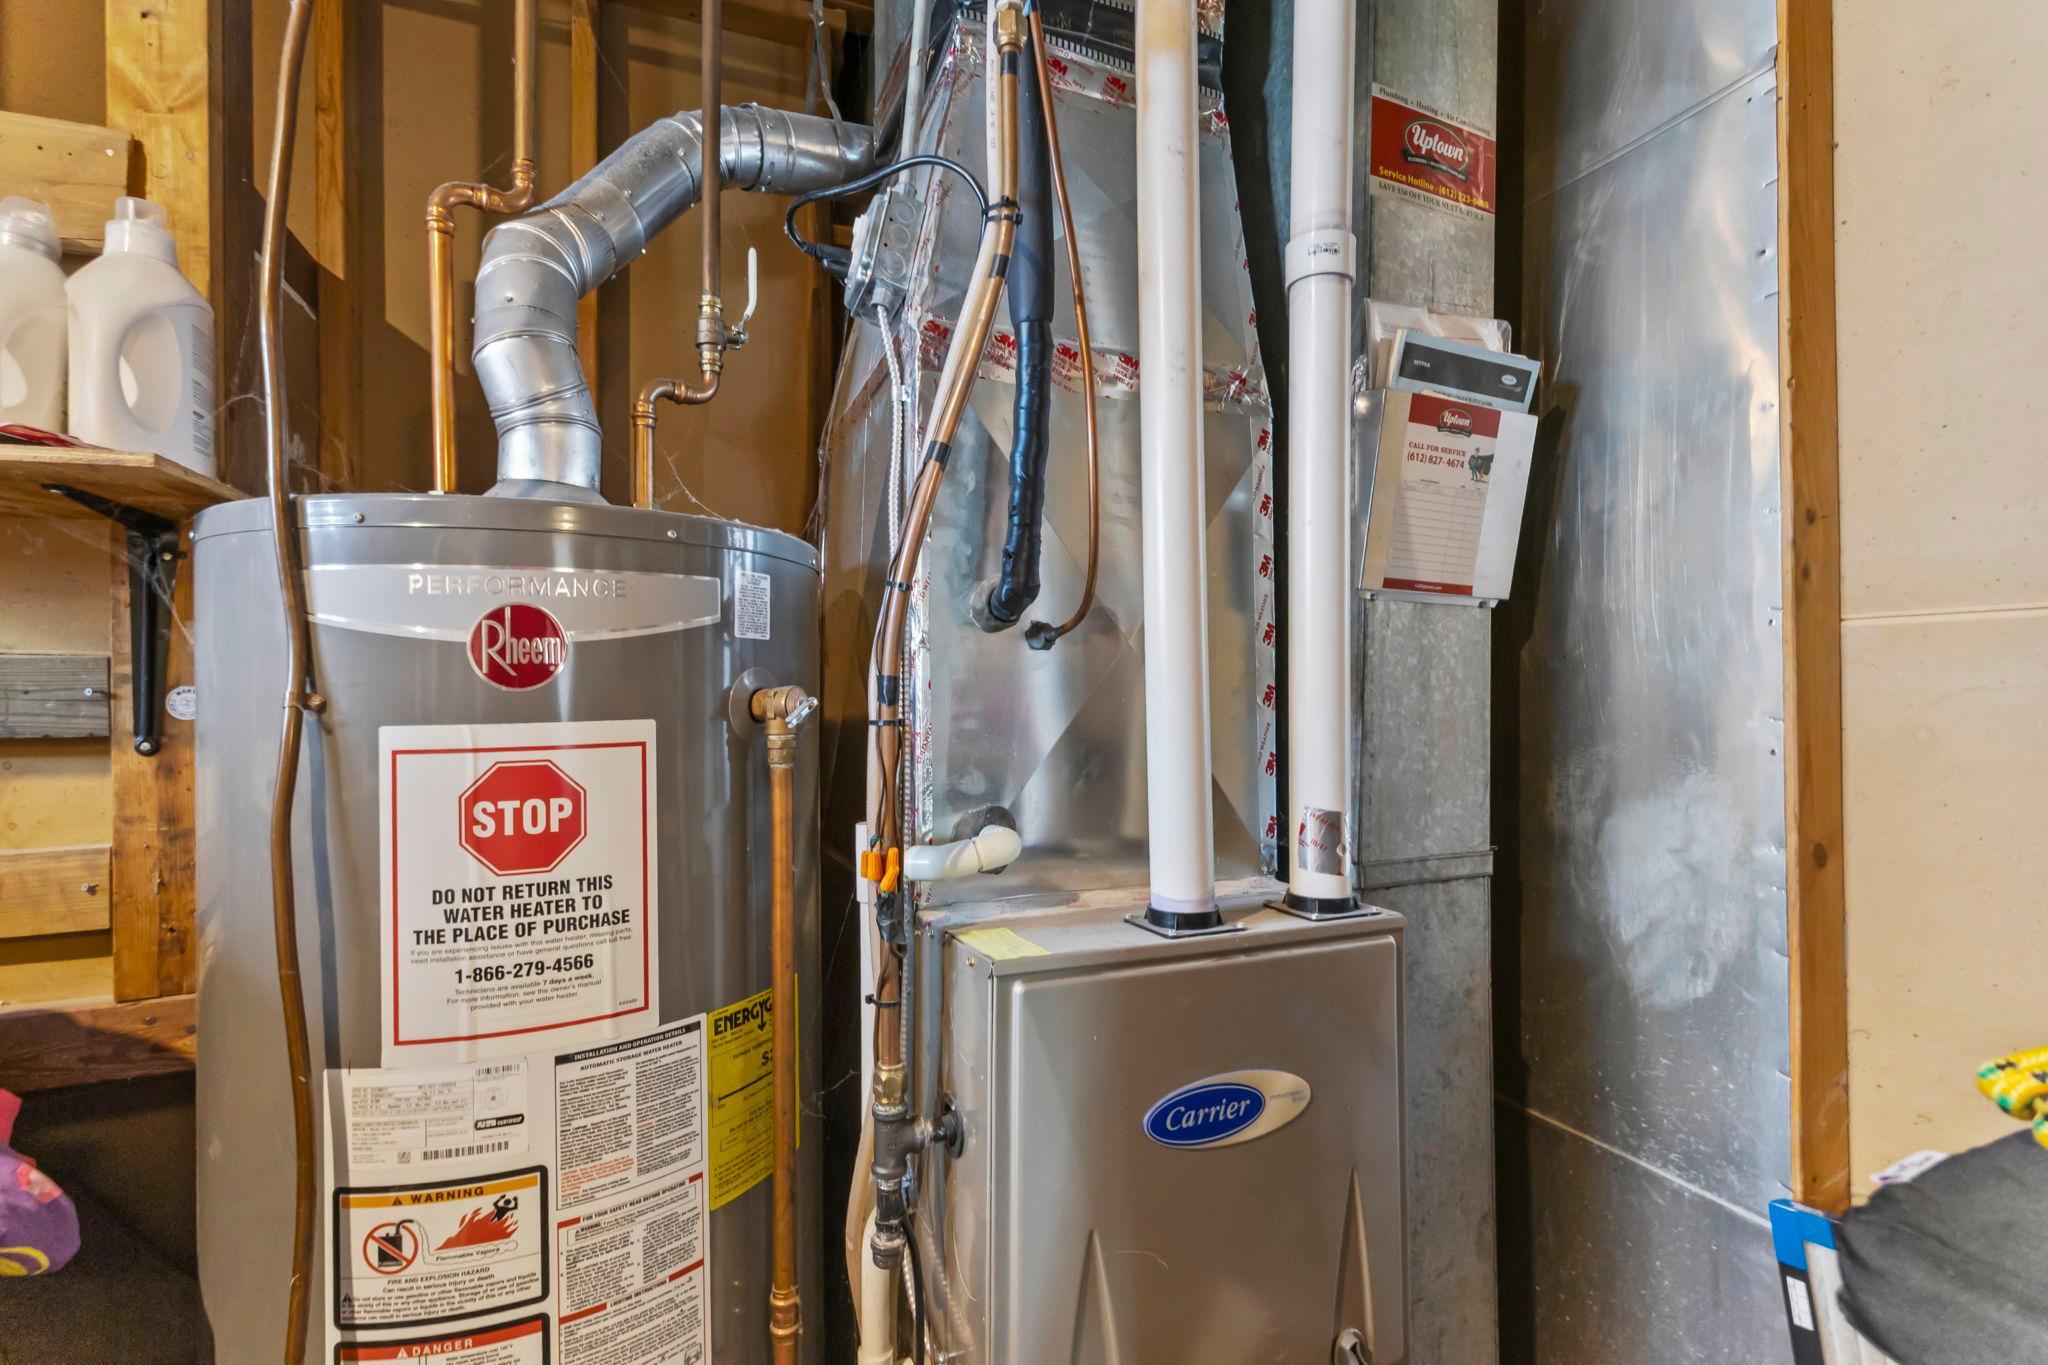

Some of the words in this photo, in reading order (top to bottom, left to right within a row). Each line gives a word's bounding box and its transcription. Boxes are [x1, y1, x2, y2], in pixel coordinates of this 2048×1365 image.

[1379, 87, 1408, 104] Plumbing
[1416, 100, 1438, 116] Heating
[1412, 124, 1464, 161] Uptown
[1378, 182, 1396, 193] SAVE
[1408, 191, 1420, 200] OFF
[1422, 194, 1440, 206] YOUR
[1379, 166, 1406, 182] Service
[1408, 176, 1434, 192] Hotline
[1439, 185, 1456, 199] (612)
[1056, 343, 1079, 362] 3M
[1444, 410, 1470, 427] Uptown
[1258, 428, 1270, 451] 3M
[1408, 441, 1425, 450] CALL
[1426, 444, 1440, 452] FOR
[1441, 446, 1466, 457] SERVICE
[1407, 451, 1428, 464] (612)
[1260, 493, 1272, 516] 3M
[1259, 554, 1272, 578] 3M
[408, 574, 628, 599] PERFORMANCE
[1258, 594, 1268, 621] WEATHER
[480, 605, 561, 676] Rheem
[1262, 622, 1276, 646] 3M
[1262, 684, 1276, 708] 3M
[1260, 722, 1272, 750] WEATHER
[1266, 752, 1276, 776] 3M
[472, 798, 573, 838] STOP
[432, 888, 455, 905] DO
[462, 886, 496, 903] NOT
[502, 880, 571, 900] RETURN
[576, 874, 613, 893] THIS
[443, 905, 504, 924] WATER
[510, 898, 576, 918] HEATER
[582, 894, 603, 910] TO
[413, 929, 446, 946] THE
[452, 924, 508, 944] PLACE
[515, 922, 537, 938] OF
[544, 909, 630, 934] PURCHASE
[444, 945, 488, 955] experiencing
[514, 940, 528, 948] with
[530, 938, 543, 946] this
[590, 929, 614, 938] missing
[468, 952, 506, 960] assistance
[516, 948, 534, 956] have
[535, 945, 561, 954] general
[562, 942, 594, 952] questions
[455, 954, 594, 984] 1-866-279-4566
[510, 980, 541, 990] available
[548, 976, 566, 986] days
[538, 986, 548, 994] the
[550, 983, 576, 992] owner's
[578, 980, 602, 988] manual
[470, 1002, 501, 1012] provided
[520, 998, 534, 1006] your
[574, 1047, 618, 1061] INSTALLATION
[618, 1043, 632, 1052] AND
[632, 1034, 664, 1048] OPERATION
[664, 1028, 686, 1038] DETAILS
[580, 1060, 615, 1072] AUTOMATIC
[616, 1052, 642, 1063] STORAGE
[644, 1046, 662, 1056] WATER
[662, 1040, 682, 1050] HEATER
[1166, 1098, 1250, 1132] Carrier
[410, 1186, 484, 1204] WARNING
[582, 1214, 592, 1222] FOR
[594, 1210, 608, 1218] YOUR
[609, 1202, 628, 1214] SAFETY
[630, 1198, 642, 1207] READ
[643, 1190, 660, 1202] BEFORE
[662, 1181, 686, 1196] OPERATING
[436, 1252, 474, 1262] Flammable
[476, 1248, 500, 1256] Vapors
[420, 1272, 460, 1282] EXPLOSION
[461, 1266, 490, 1276] HAZARD
[412, 1338, 474, 1356] DANGER
